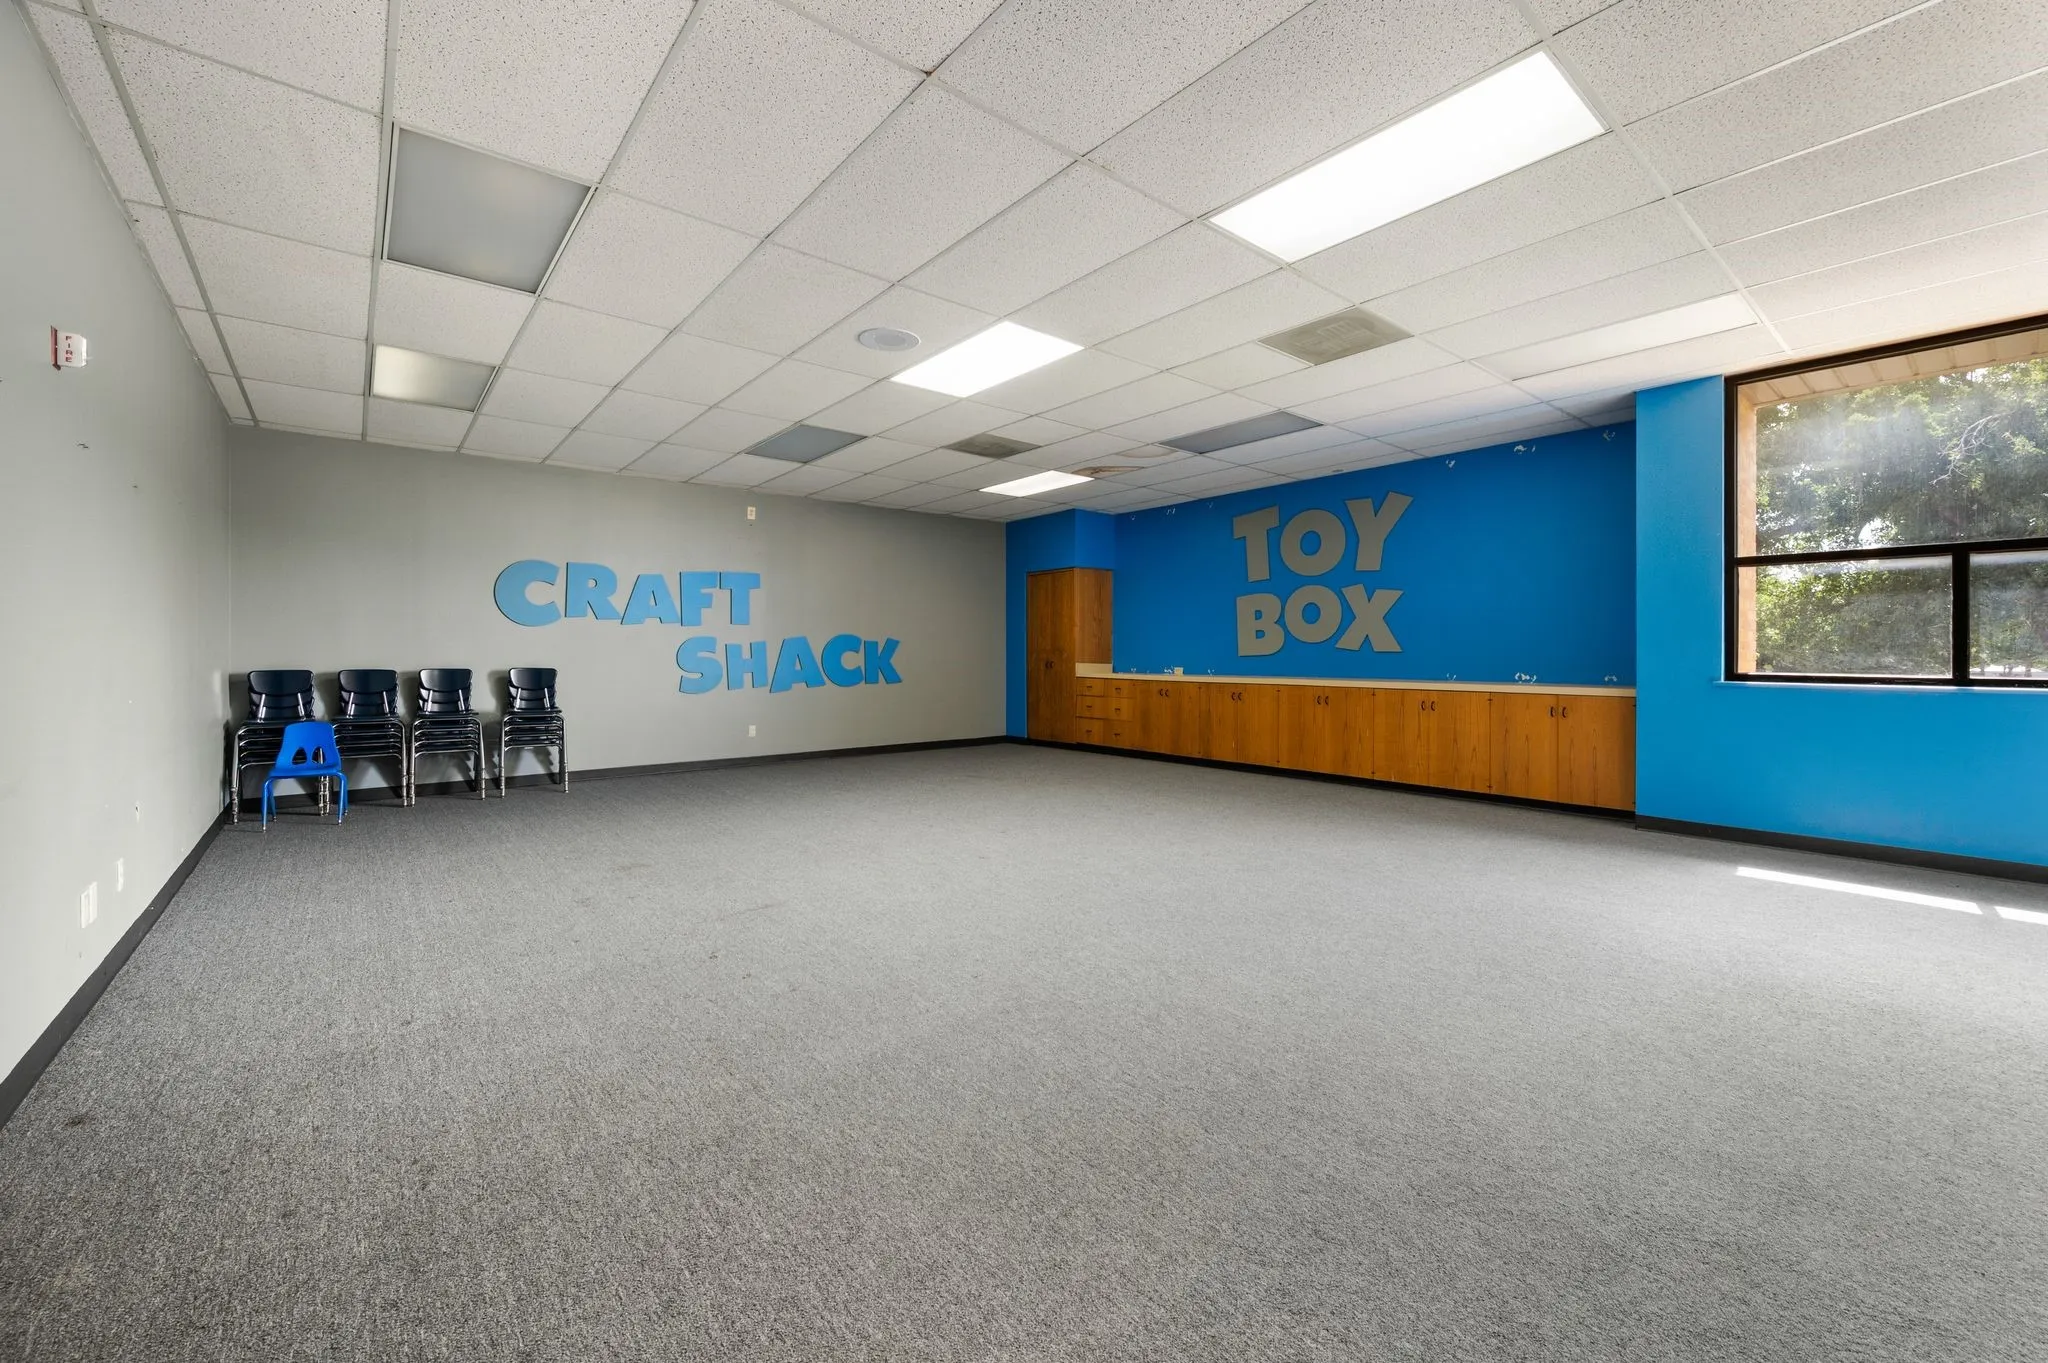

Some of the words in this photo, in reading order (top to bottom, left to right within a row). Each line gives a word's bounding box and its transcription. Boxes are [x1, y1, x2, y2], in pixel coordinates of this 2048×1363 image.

[65, 335, 73, 363] FIRE
[1232, 491, 1414, 582] TOY
[493, 559, 761, 628] CRAFT
[1235, 583, 1404, 657] BOX
[675, 633, 903, 694] SHACK
